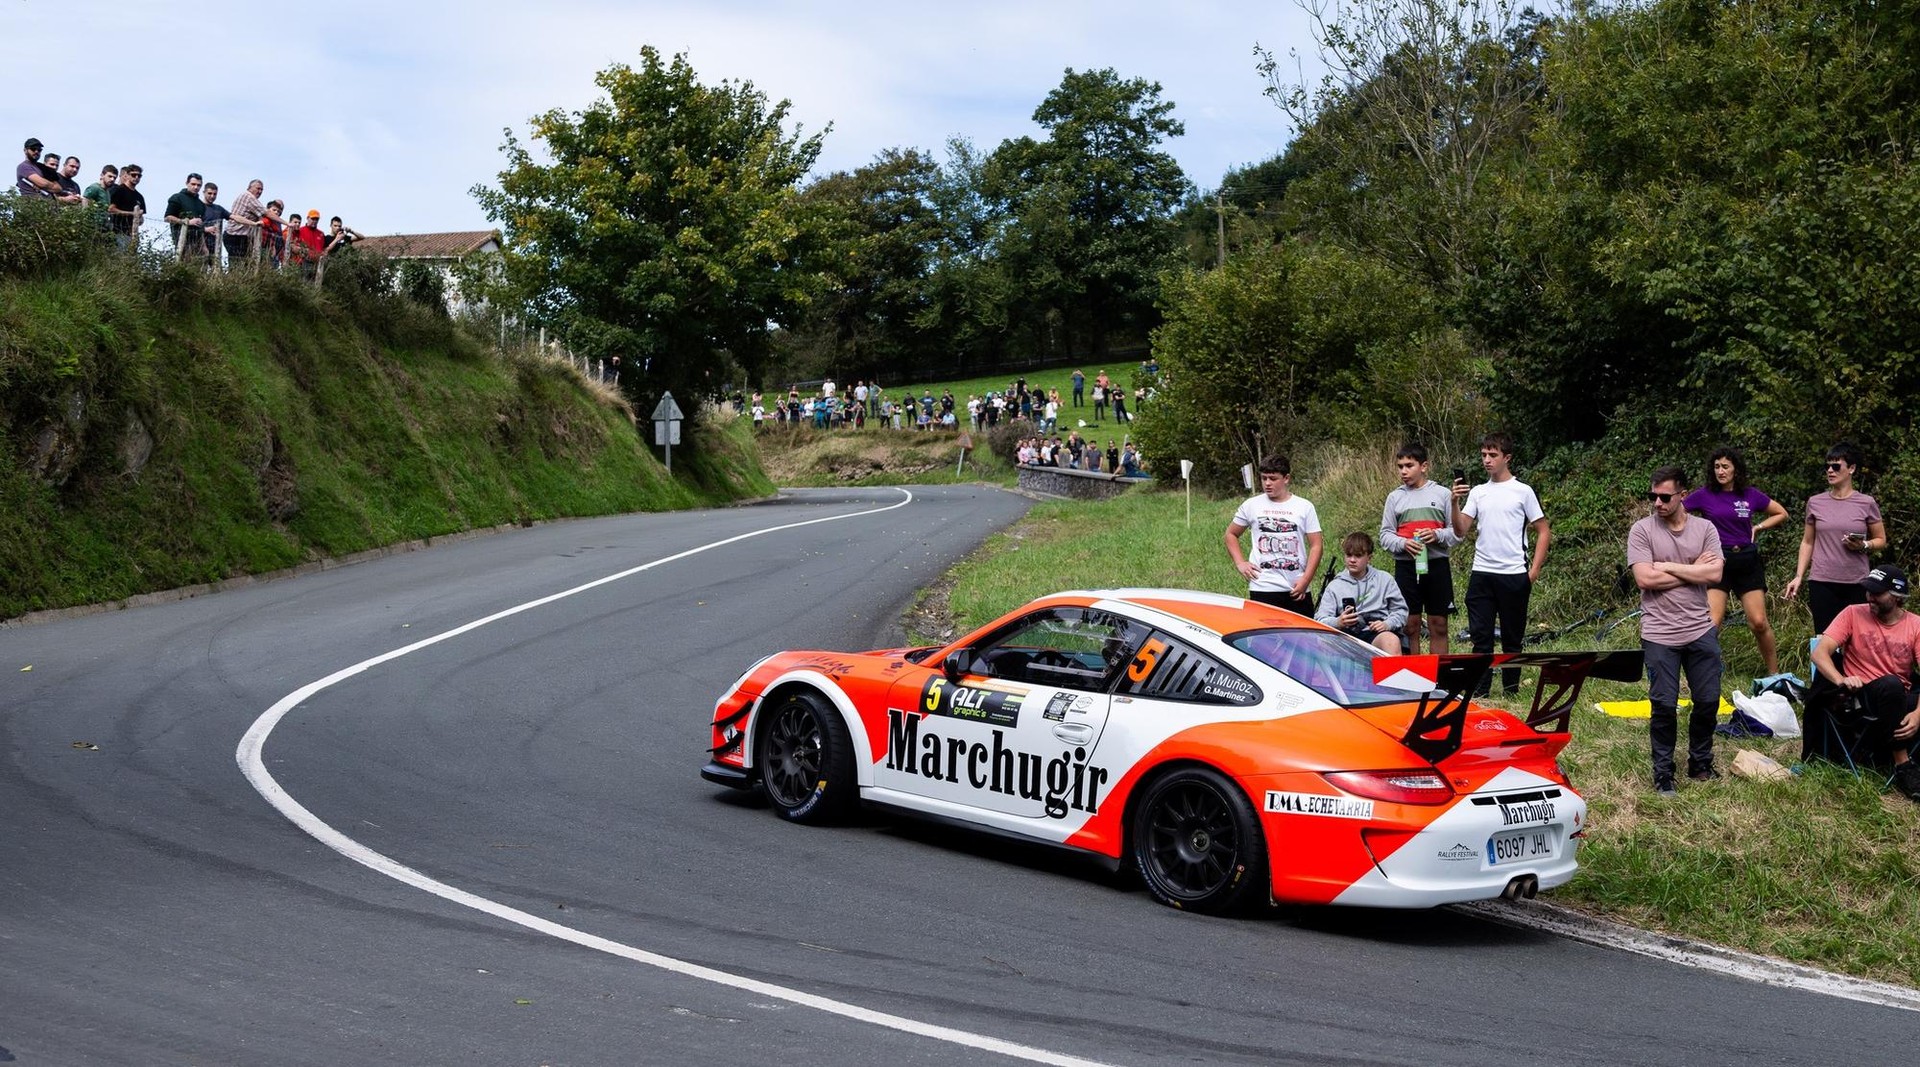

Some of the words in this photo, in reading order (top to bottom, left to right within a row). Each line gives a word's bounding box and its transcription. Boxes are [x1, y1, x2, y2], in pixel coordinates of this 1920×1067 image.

[1128, 638, 1167, 682] 5
[926, 678, 947, 711] 5
[950, 687, 991, 709] ALT
[886, 709, 1108, 819] Marchugir
[1499, 800, 1556, 825] Marchugir
[1496, 837, 1525, 859] 6097
[1531, 833, 1550, 855] JHL
